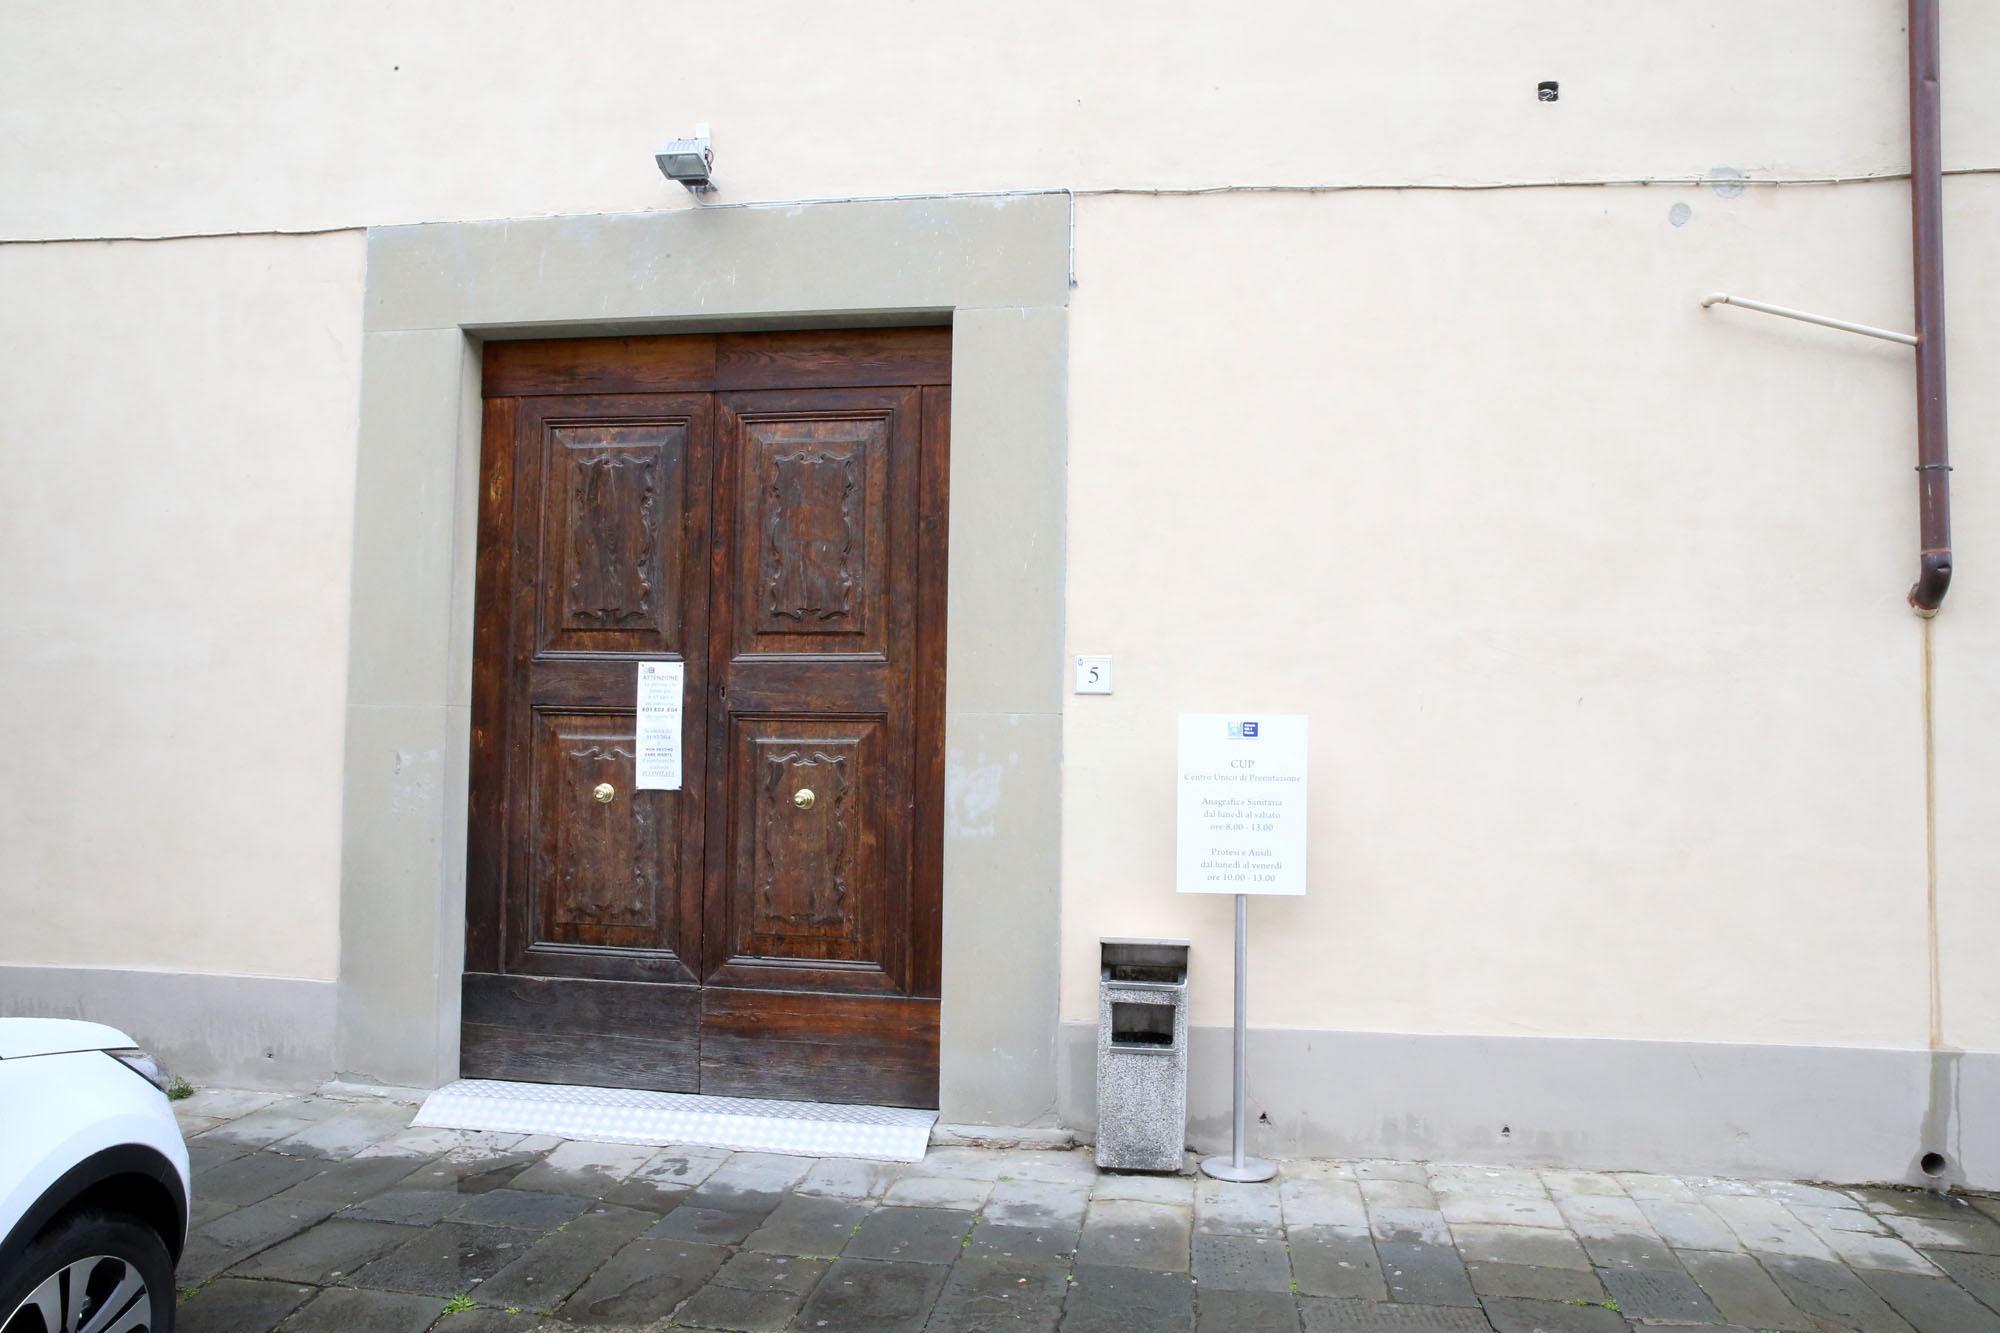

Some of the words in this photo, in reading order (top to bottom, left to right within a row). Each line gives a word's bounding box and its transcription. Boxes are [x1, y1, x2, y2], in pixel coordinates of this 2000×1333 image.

[1088, 666, 1099, 684] 5
[1230, 759, 1255, 769] CUP
[1184, 773, 1212, 781] Centro
[1213, 773, 1237, 781] Unico
[1239, 773, 1247, 781] di
[1249, 774, 1301, 782] Prenotazione
[1201, 797, 1244, 807] Anagrafica
[1246, 798, 1283, 806] Sanitaria
[1203, 810, 1216, 818] dal
[1245, 811, 1252, 819] al
[1254, 811, 1281, 819] sabato
[1225, 823, 1243, 831] 8.00
[1251, 823, 1274, 831] 13.00
[1211, 848, 1239, 856] Protesi
[1200, 860, 1213, 868] dal
[1243, 861, 1250, 869] al
[1222, 873, 1246, 881] 10.00
[1252, 874, 1275, 882] 13.00
